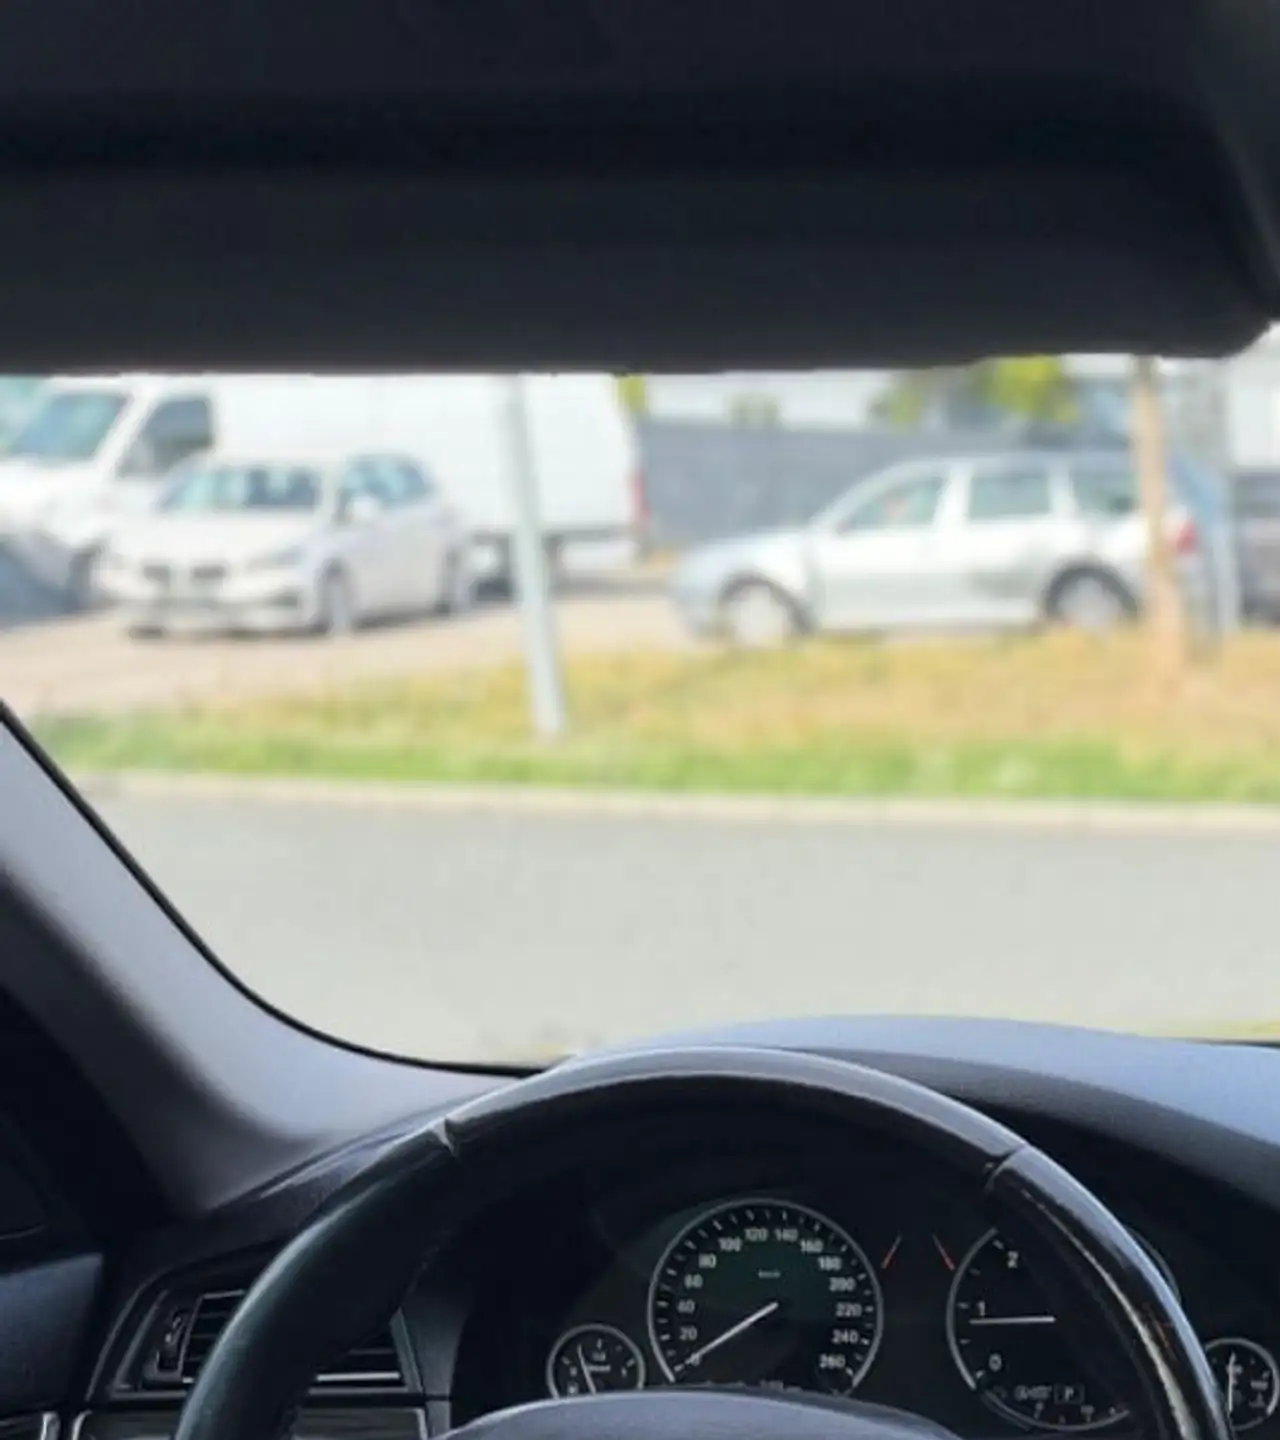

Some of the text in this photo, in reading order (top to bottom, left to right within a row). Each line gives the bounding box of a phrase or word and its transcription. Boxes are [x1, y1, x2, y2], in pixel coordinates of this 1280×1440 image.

[744, 1227, 768, 1241] 120
[1008, 1250, 1019, 1268] 2
[679, 1326, 698, 1341] 20
[831, 1329, 860, 1344] 240
